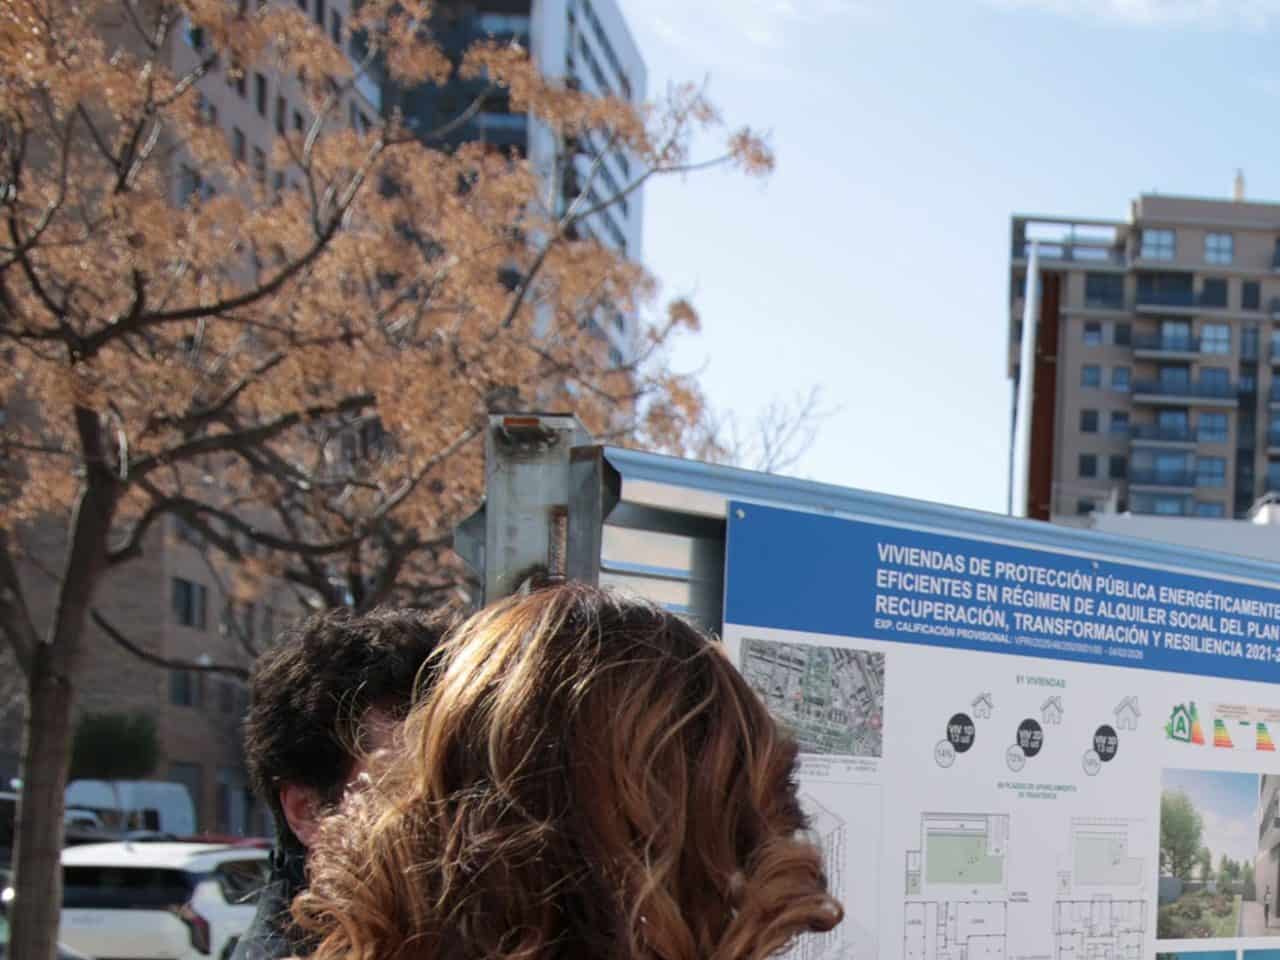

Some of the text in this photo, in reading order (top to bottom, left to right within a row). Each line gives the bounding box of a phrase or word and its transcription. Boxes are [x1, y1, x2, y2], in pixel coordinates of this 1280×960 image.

[877, 543, 966, 573] VIVIENDAS
[969, 557, 991, 577] DE
[995, 562, 1092, 592] PROTECCIÓN
[1096, 574, 1156, 601] PÚBLICA
[875, 594, 1009, 632] RECUPERACIÓN,
[1014, 612, 1149, 646] TRANSFORMACIÓN
[1152, 631, 1162, 647] Y
[1164, 632, 1242, 657] RESILIENCIA
[876, 569, 972, 599] EFICIENTES
[976, 583, 997, 603] EN
[1002, 584, 1070, 612] RÉGIMEN
[1074, 597, 1094, 615] DE
[1097, 601, 1166, 625] ALQUILER
[1169, 610, 1217, 632] SOCIAL
[1220, 617, 1244, 635] DEL
[1247, 621, 1279, 641] PLAN
[896, 622, 955, 637] CALIFICACIÓN
[1175, 716, 1187, 734] A
